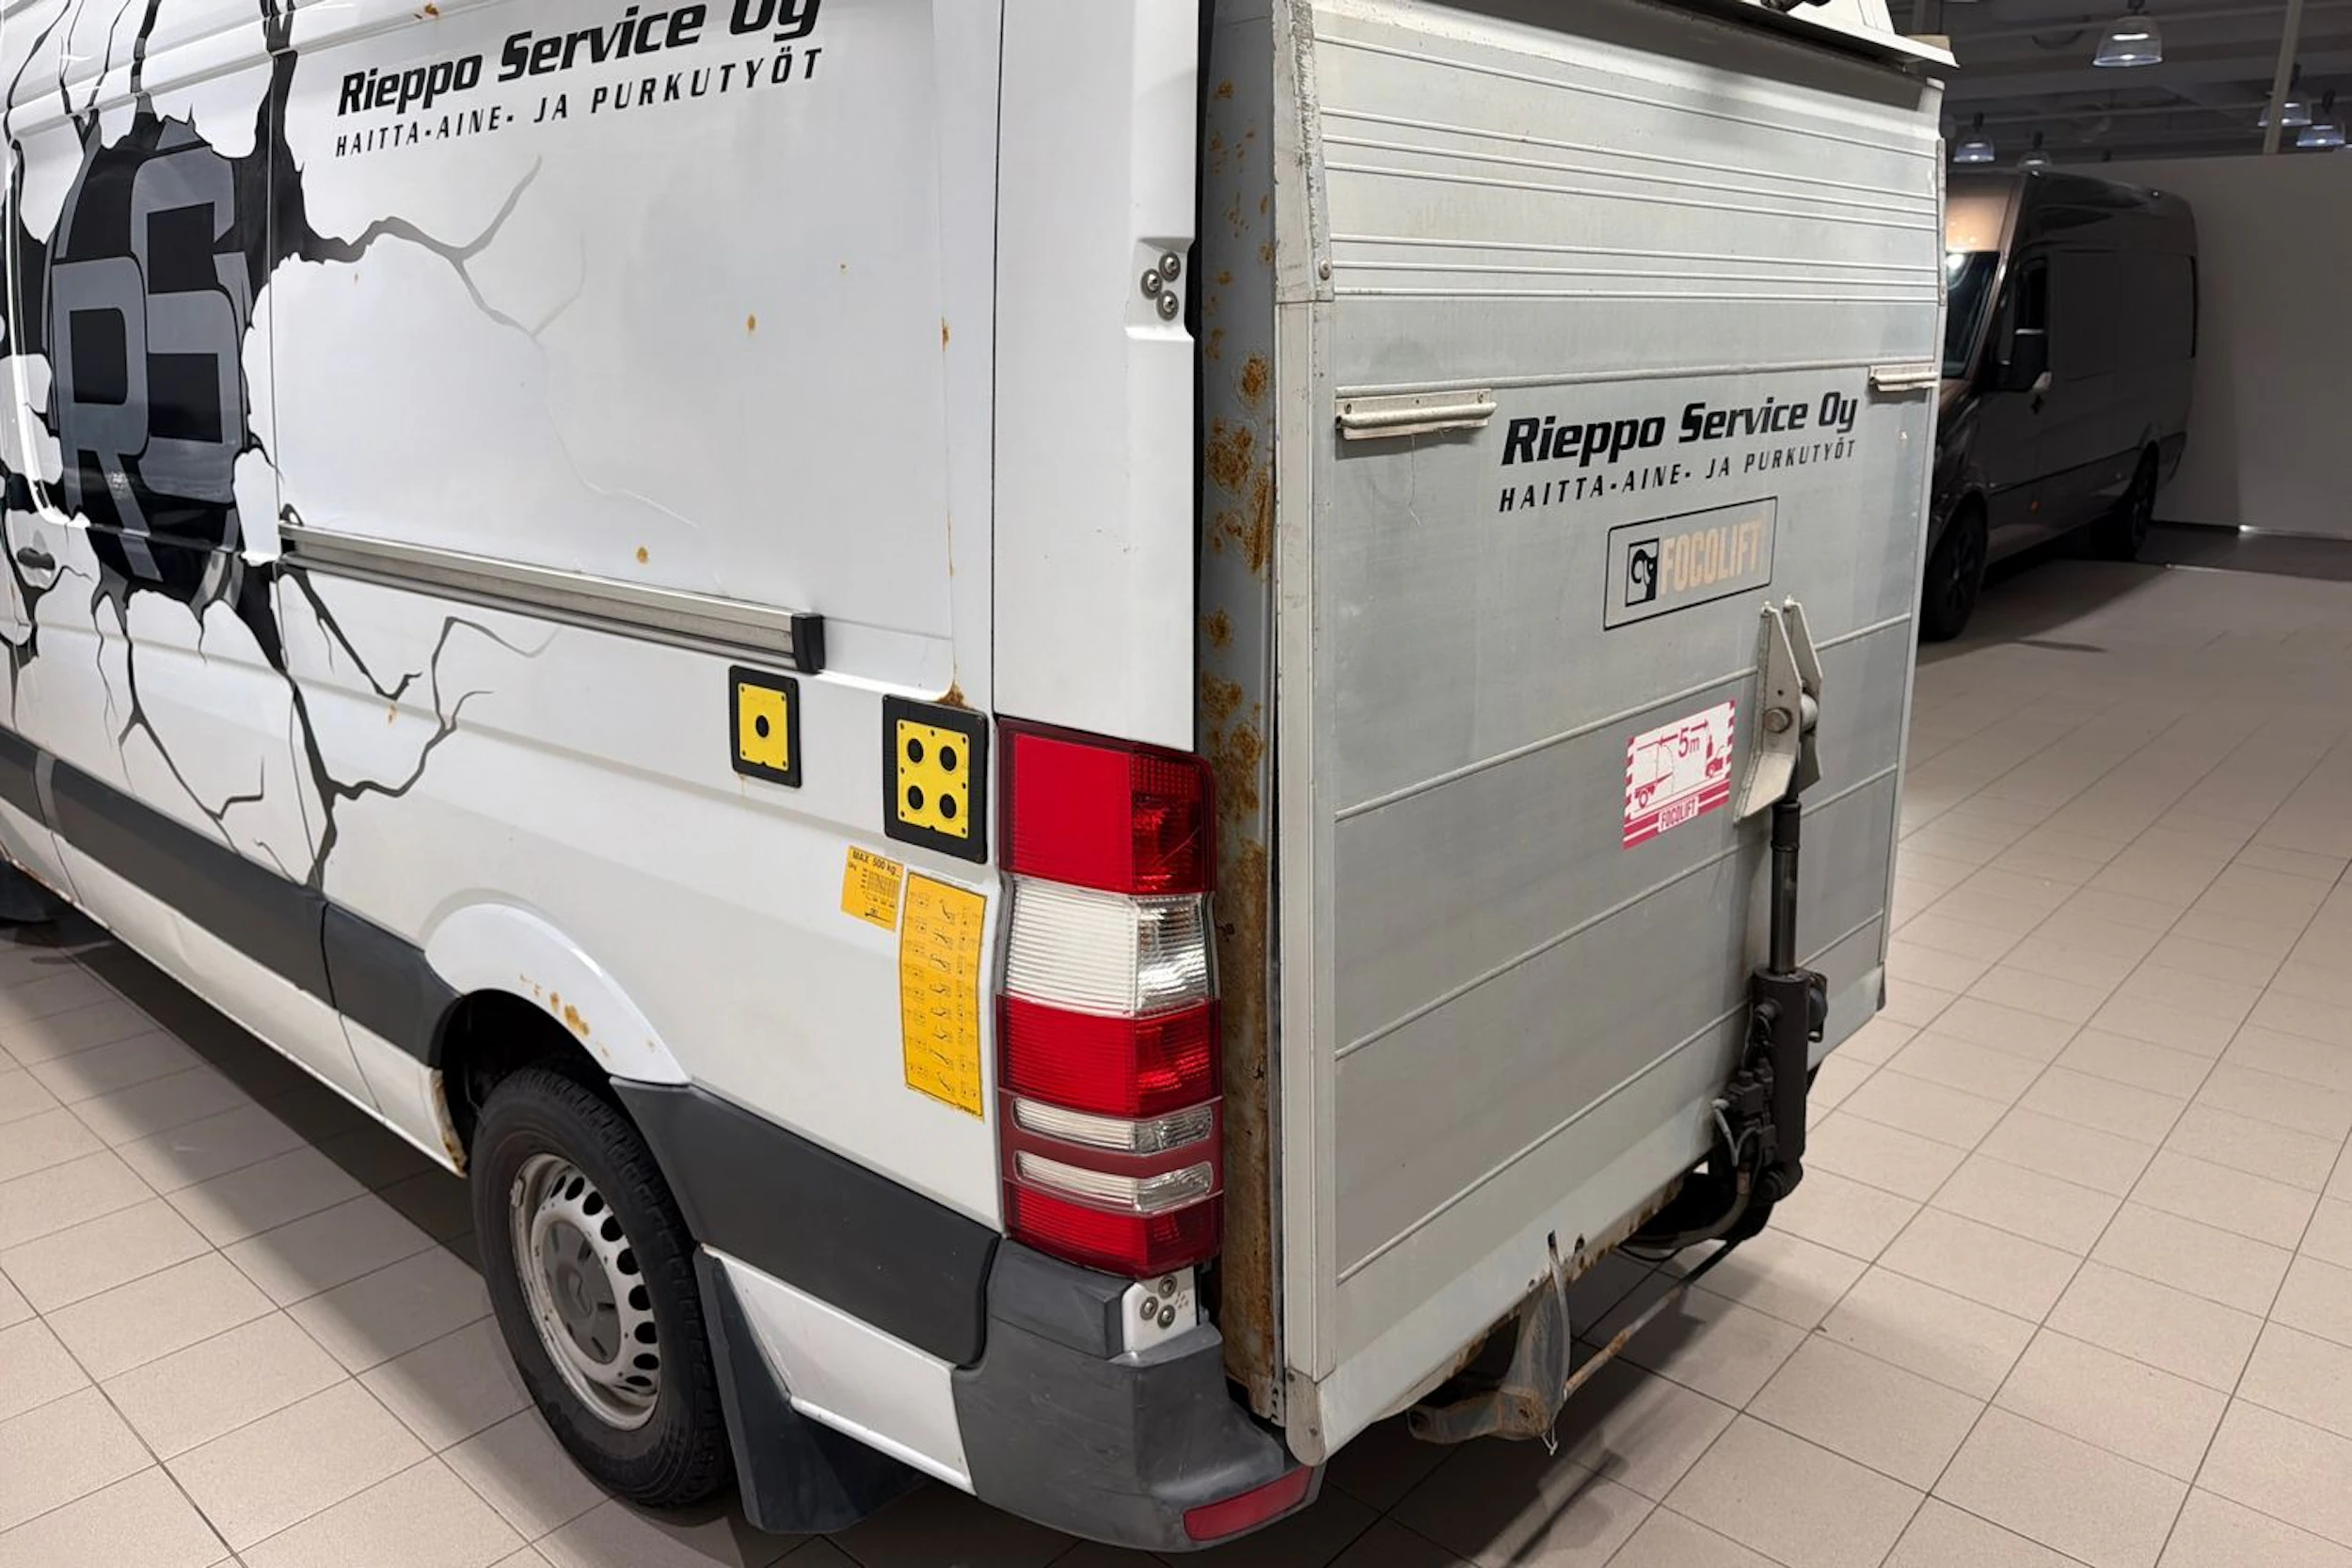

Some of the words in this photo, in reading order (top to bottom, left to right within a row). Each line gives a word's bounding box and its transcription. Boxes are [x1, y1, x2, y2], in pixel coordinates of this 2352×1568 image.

[337, 55, 484, 117] Rieppo
[498, 3, 707, 83] Service
[730, 0, 821, 42] Oy
[336, 105, 514, 158] HAITTA-AINE-
[533, 94, 567, 123] JA
[591, 45, 822, 114] PURKUTYÖT
[1501, 416, 1666, 468] Rieppo
[1677, 396, 1808, 444] Service
[1819, 391, 1858, 435] Oy
[1499, 464, 1692, 513] HAITTA-AINE-
[1705, 456, 1729, 480] JA
[1743, 439, 1855, 473] PURKUTYÖT
[1661, 518, 1762, 596] FOCOLIFT
[1661, 799, 1695, 829] FOCOLIFT
